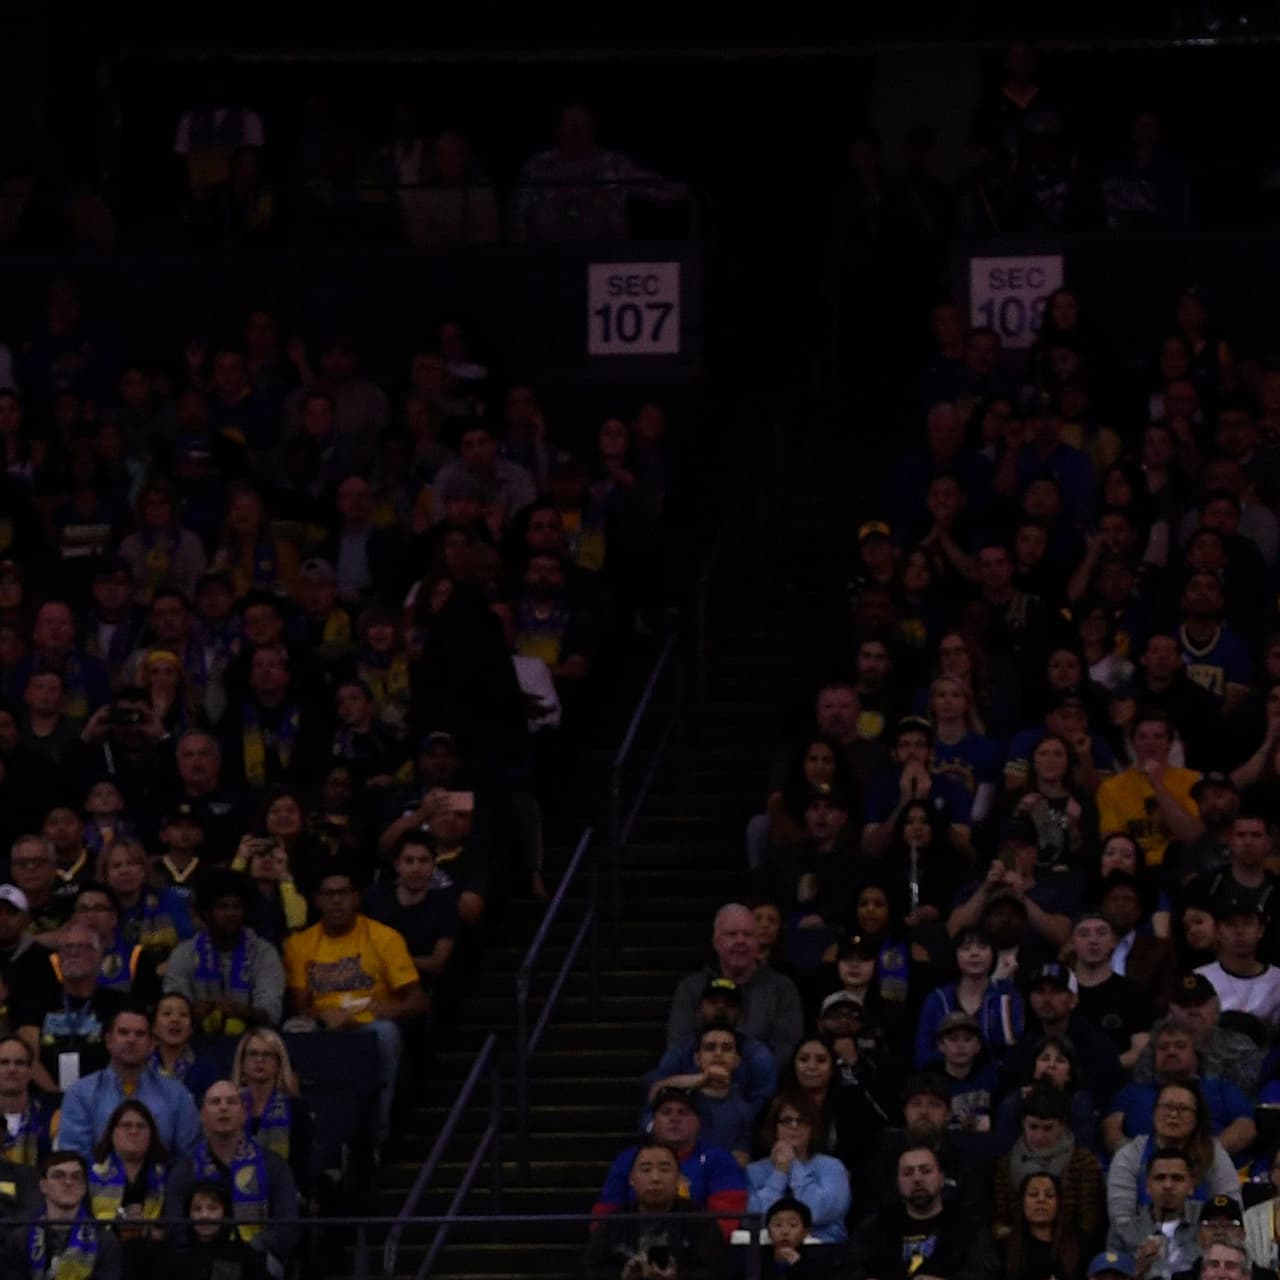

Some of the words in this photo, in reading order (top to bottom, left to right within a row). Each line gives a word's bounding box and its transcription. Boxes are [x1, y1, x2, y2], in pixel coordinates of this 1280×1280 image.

[606, 274, 660, 298] SEC
[988, 267, 1046, 291] SEC
[594, 302, 675, 343] 107
